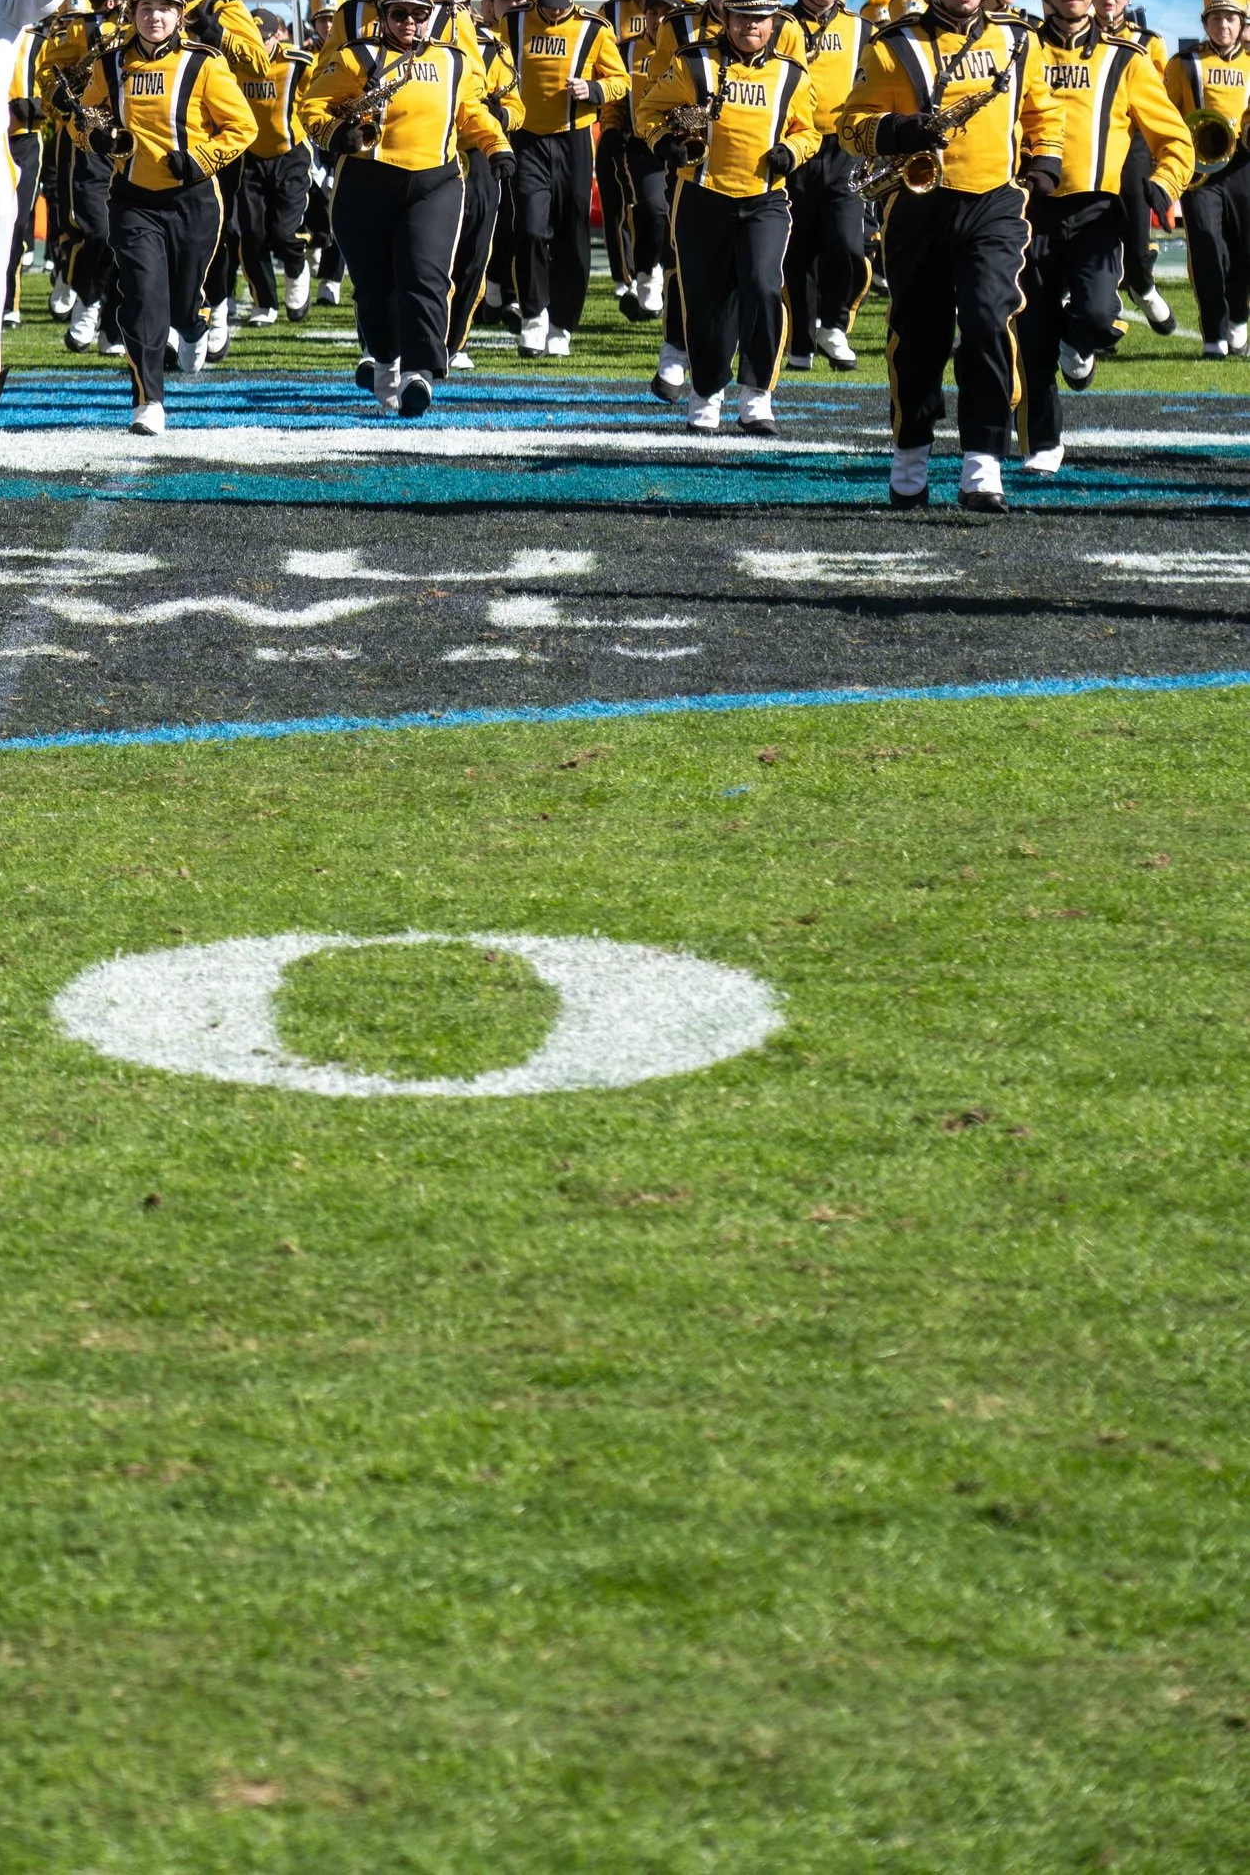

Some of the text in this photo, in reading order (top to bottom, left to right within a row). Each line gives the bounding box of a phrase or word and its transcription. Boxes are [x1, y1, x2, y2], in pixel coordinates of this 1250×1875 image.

[530, 35, 567, 57] IOWA
[131, 72, 165, 96] IOWA
[1044, 65, 1091, 89] IOWA
[1207, 68, 1245, 88] IOWA
[243, 82, 277, 99] IOWA
[52, 928, 786, 1097] 0
